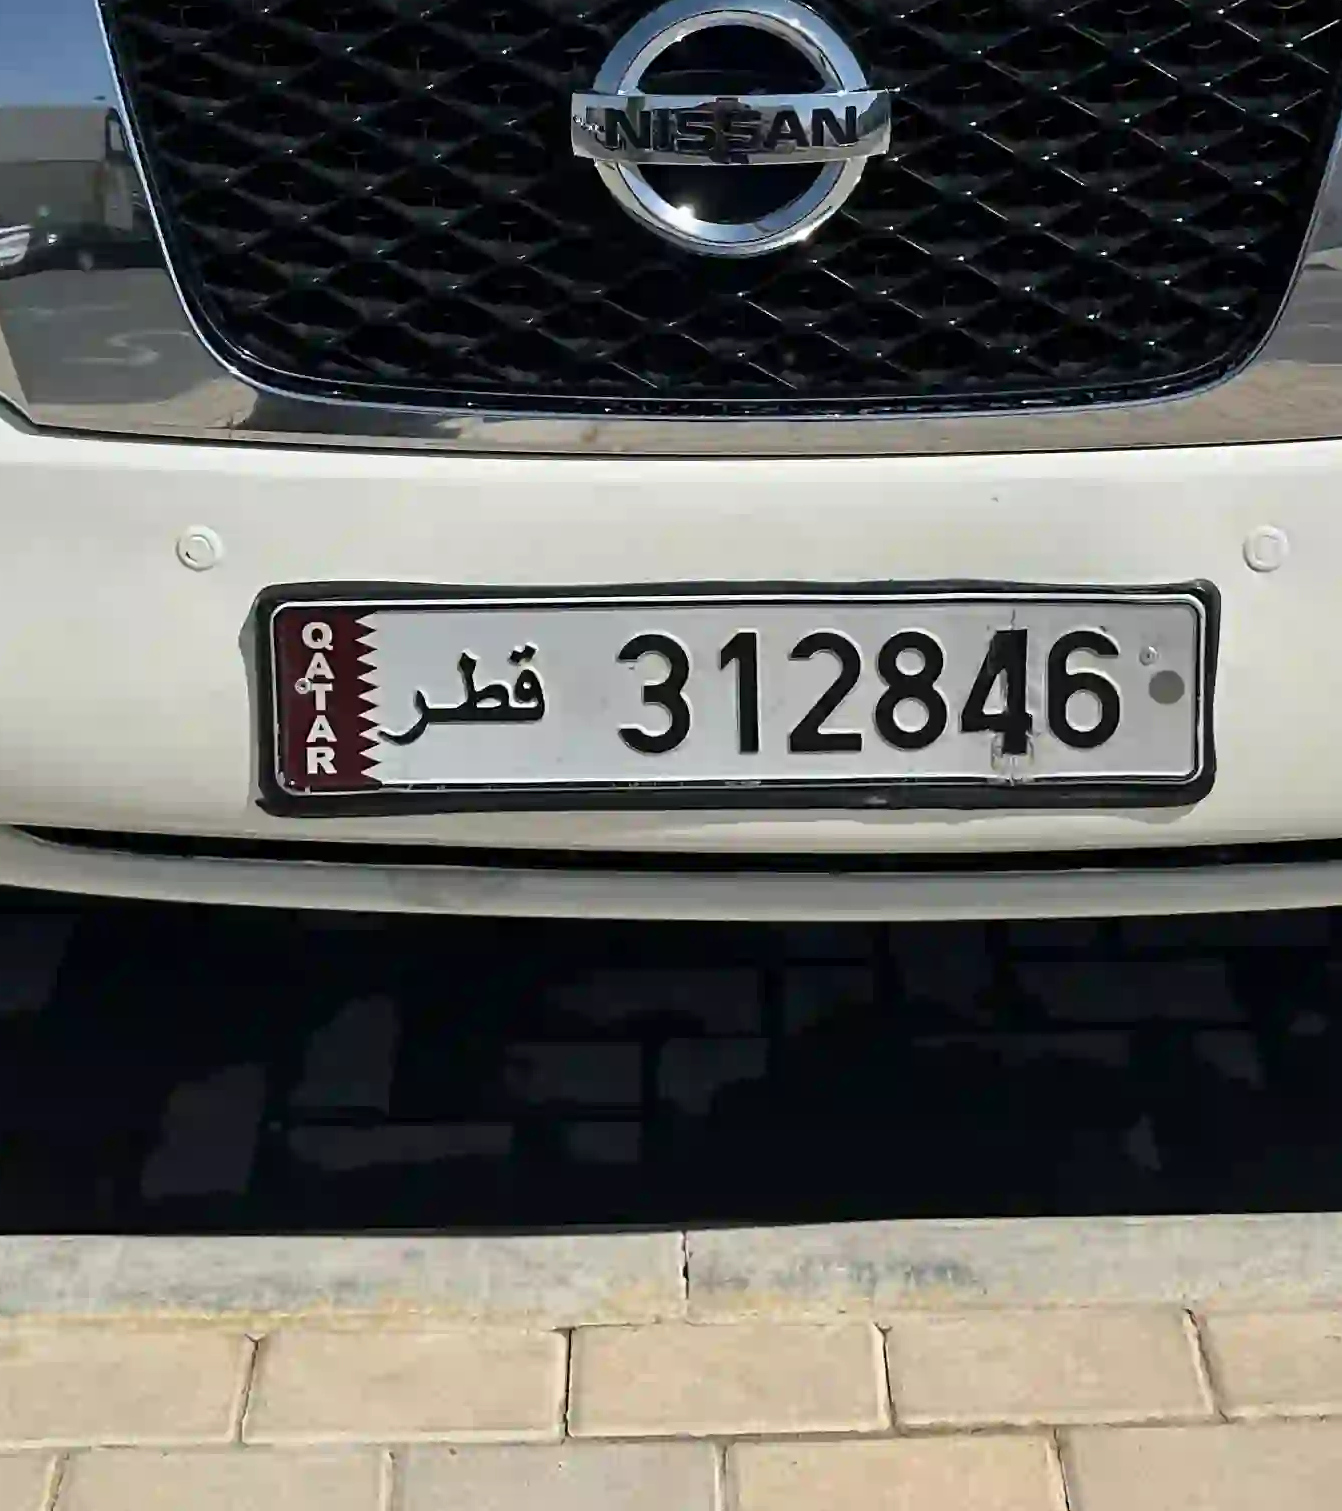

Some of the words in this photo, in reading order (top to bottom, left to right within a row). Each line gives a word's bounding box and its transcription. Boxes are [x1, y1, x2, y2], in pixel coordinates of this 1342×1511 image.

[602, 104, 858, 152] NISSAN
[300, 620, 338, 776] QATAR
[377, 640, 546, 747] قطر
[616, 625, 1121, 756] 312846
